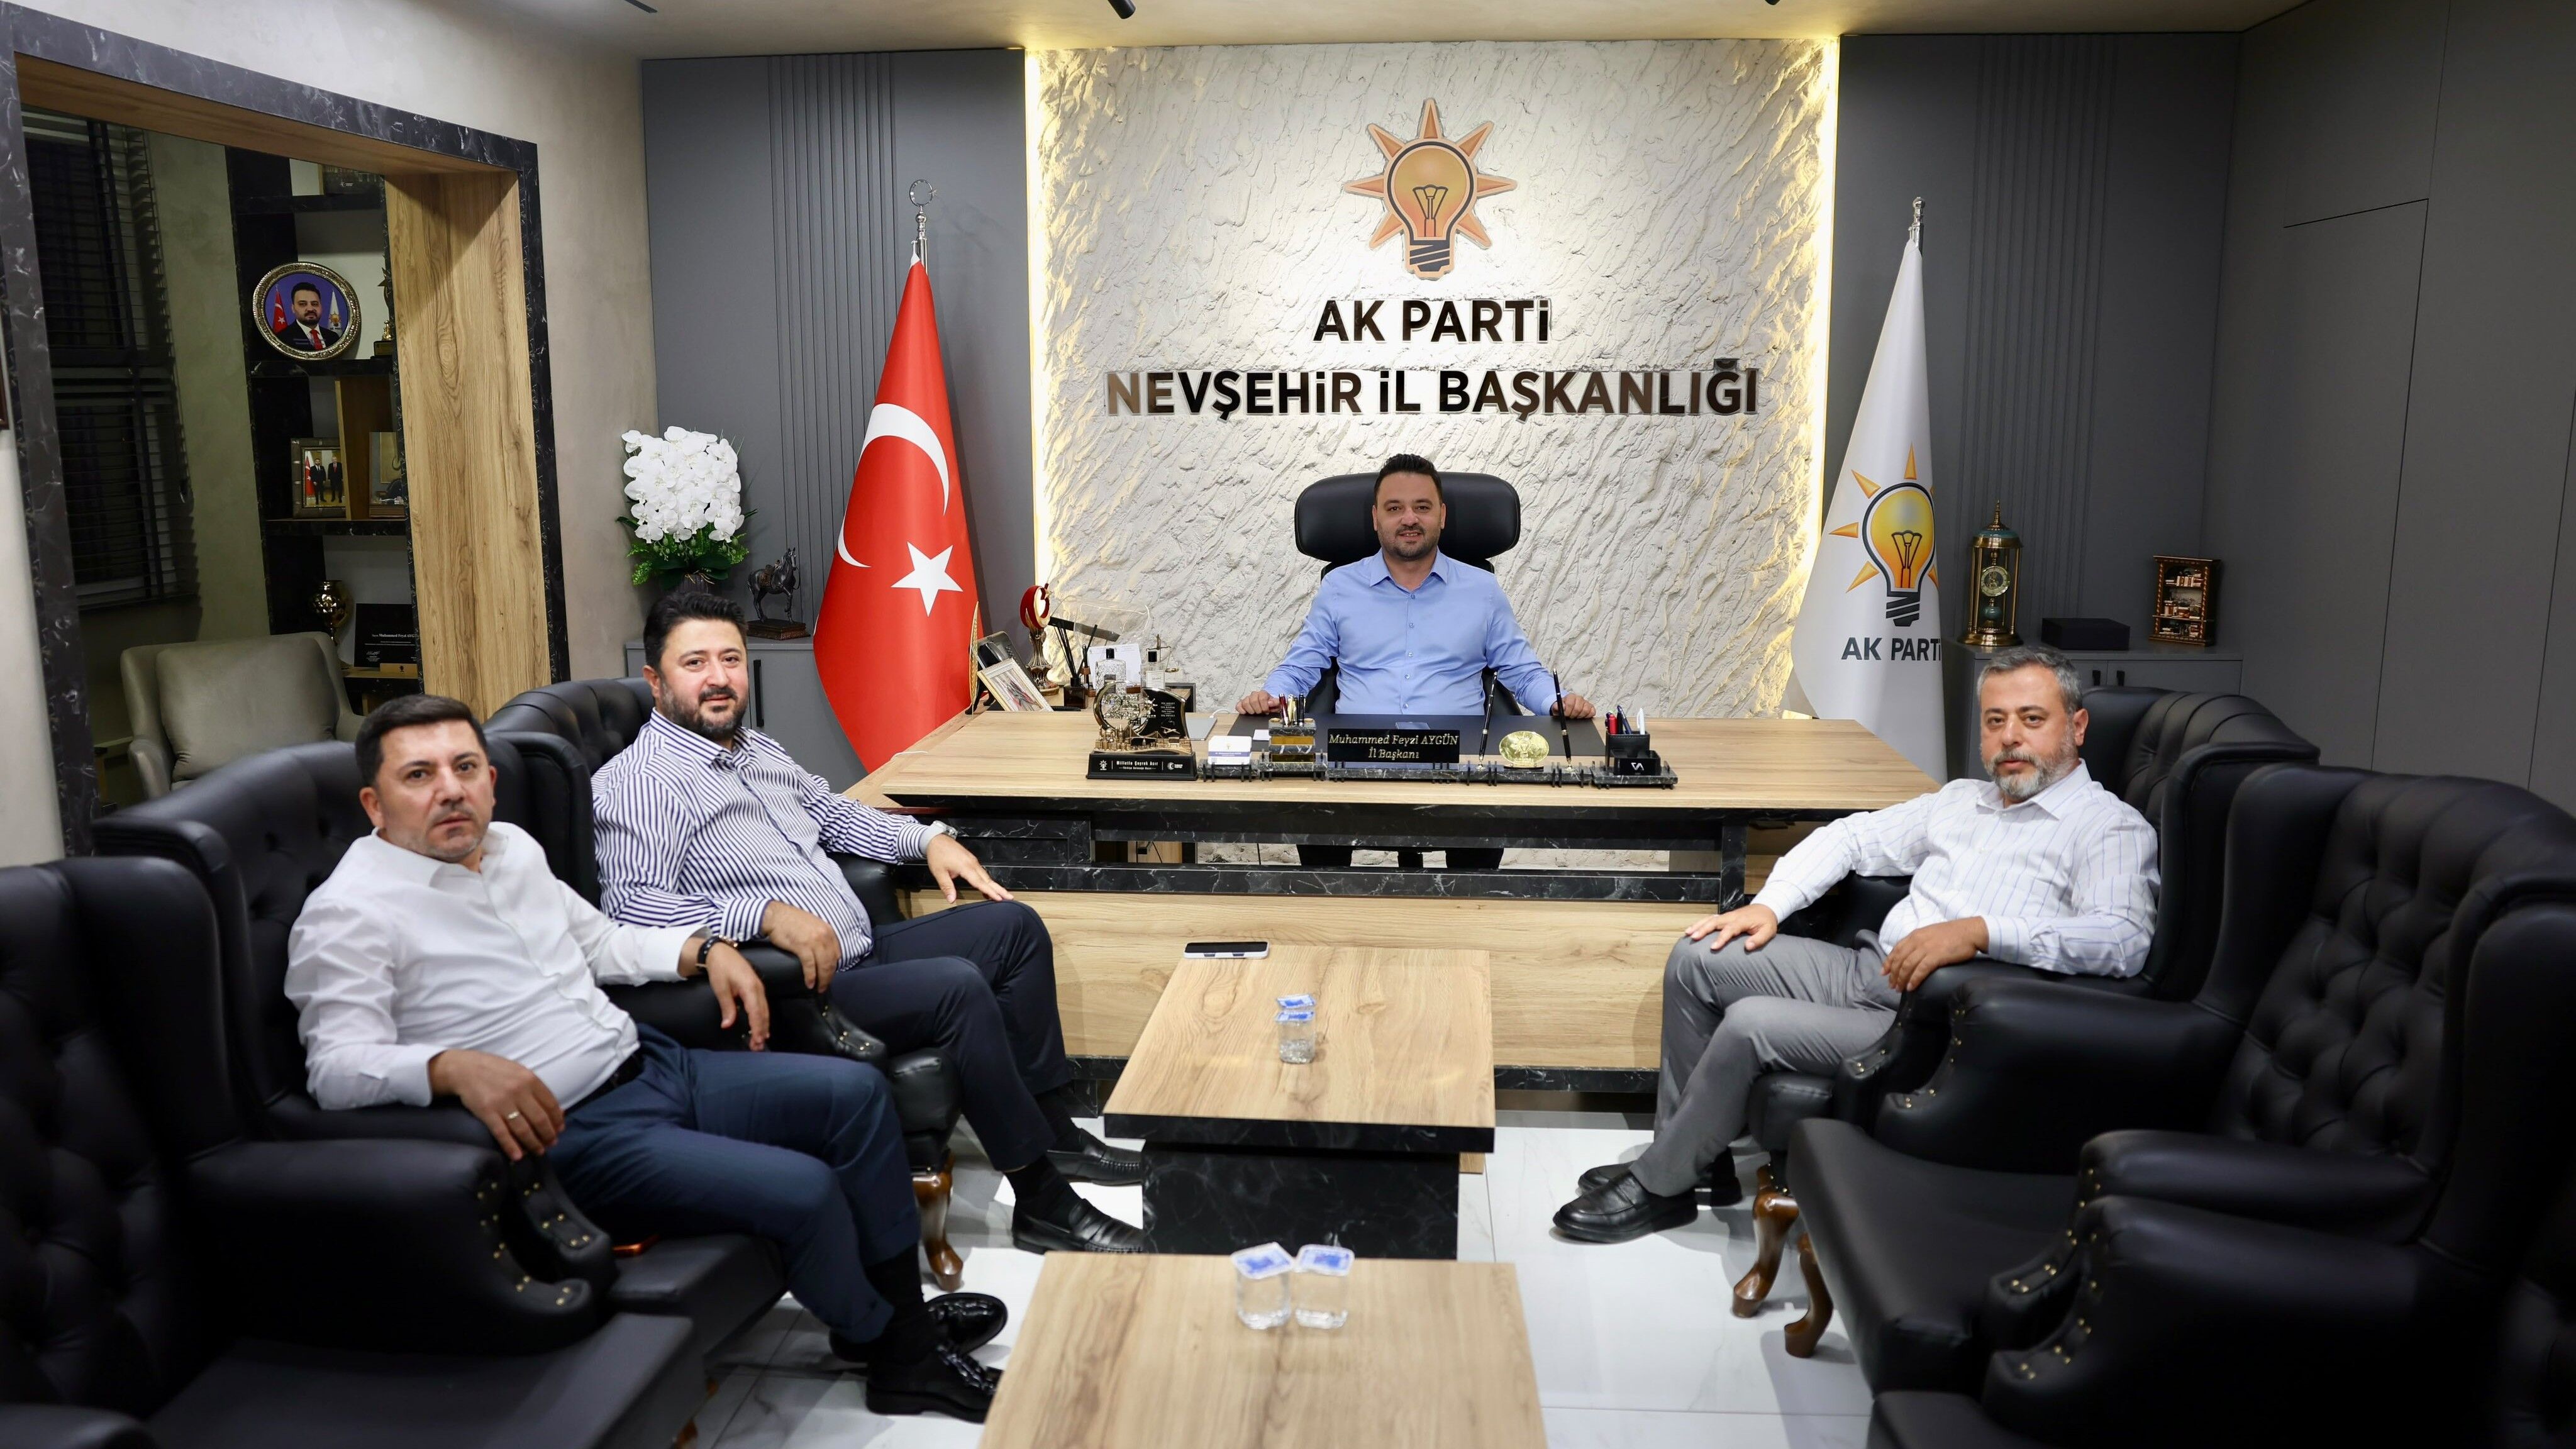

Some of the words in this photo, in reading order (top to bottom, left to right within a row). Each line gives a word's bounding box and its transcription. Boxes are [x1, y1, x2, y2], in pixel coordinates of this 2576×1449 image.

[1313, 300, 1385, 341] AK
[1439, 360, 1758, 422] BAŞKANLIĞI
[1841, 637, 1883, 660] AK
[1328, 734, 1390, 745] Muhammed
[1392, 735, 1419, 747] Feyzi
[1420, 733, 1459, 745] AYGÜN
[1378, 748, 1419, 760] Başkanı
